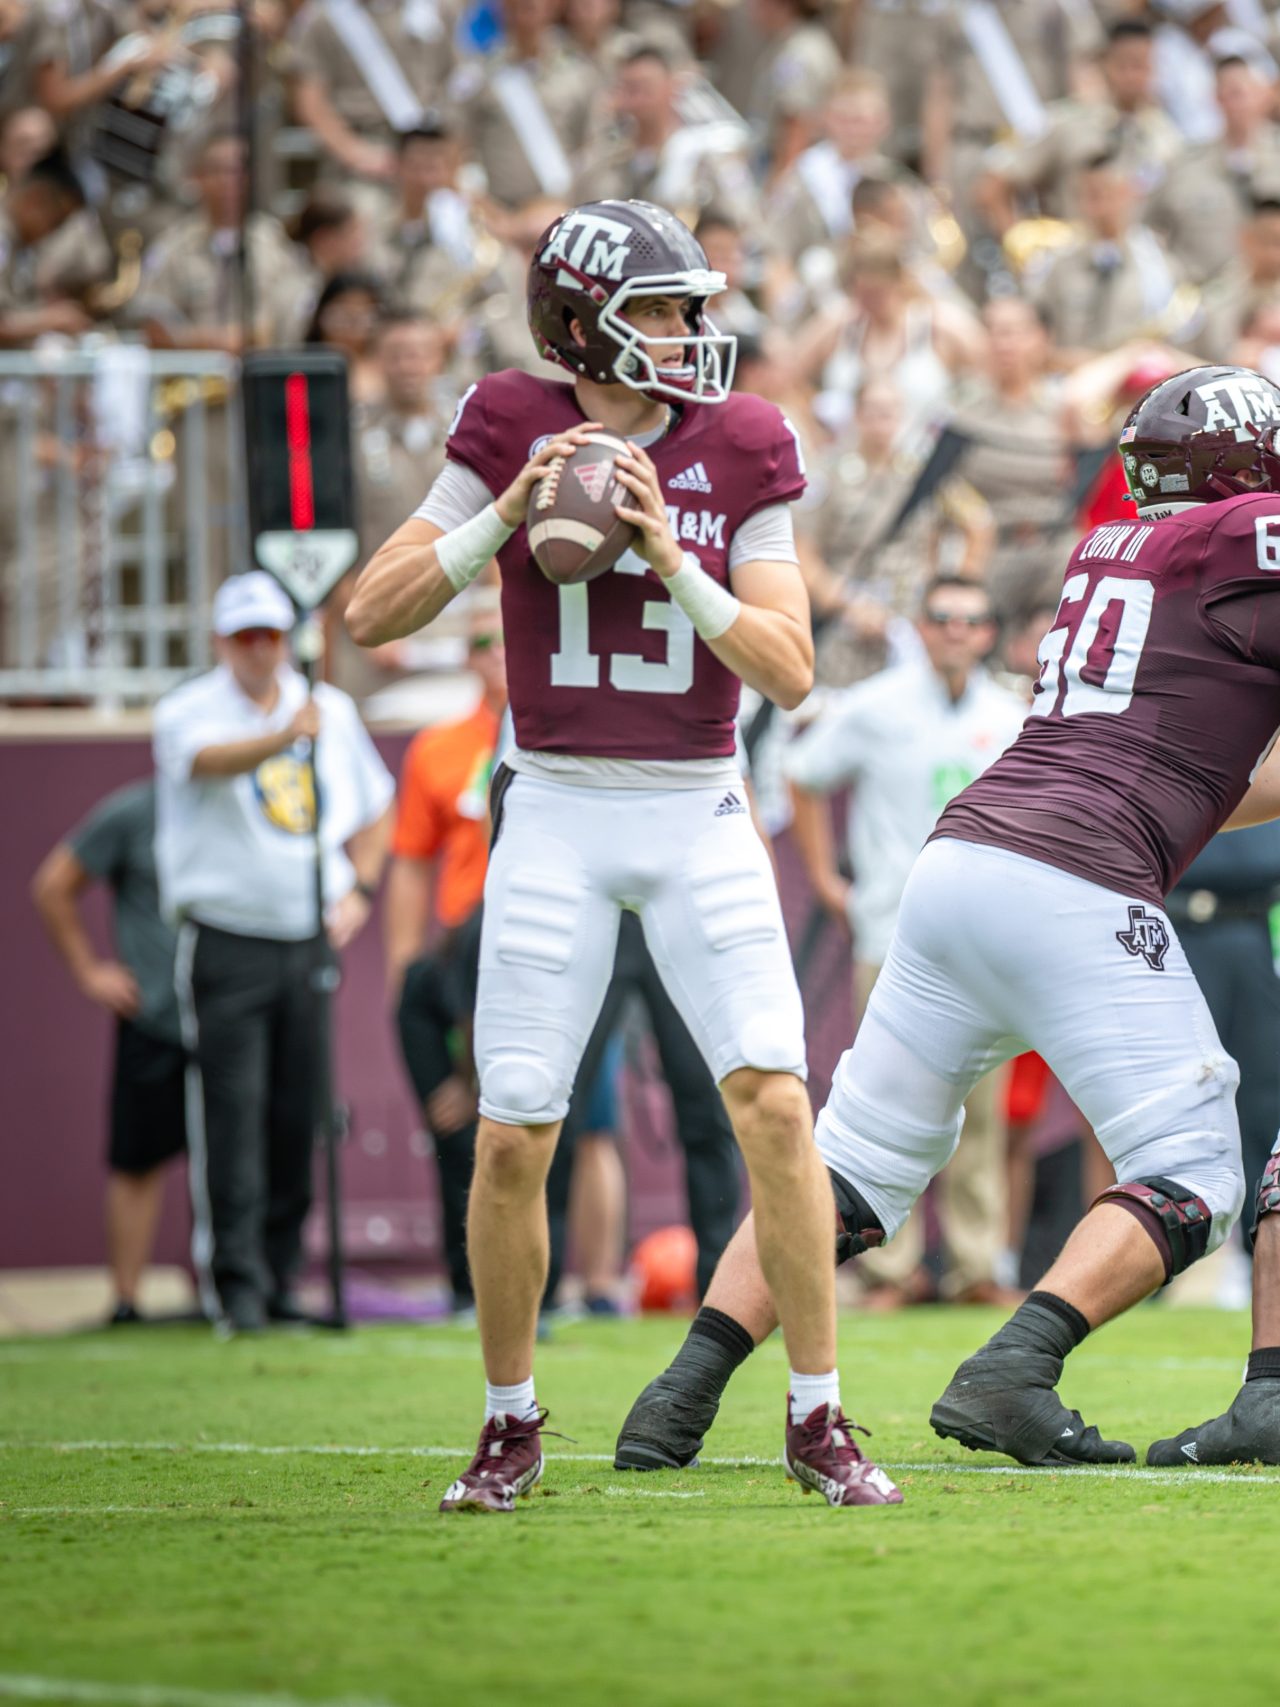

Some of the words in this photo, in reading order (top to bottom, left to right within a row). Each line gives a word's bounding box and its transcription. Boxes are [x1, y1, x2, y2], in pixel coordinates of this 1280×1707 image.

[667, 478, 712, 494] adidas
[1120, 525, 1155, 563] III
[551, 548, 702, 694] 13
[1031, 572, 1156, 717] 60
